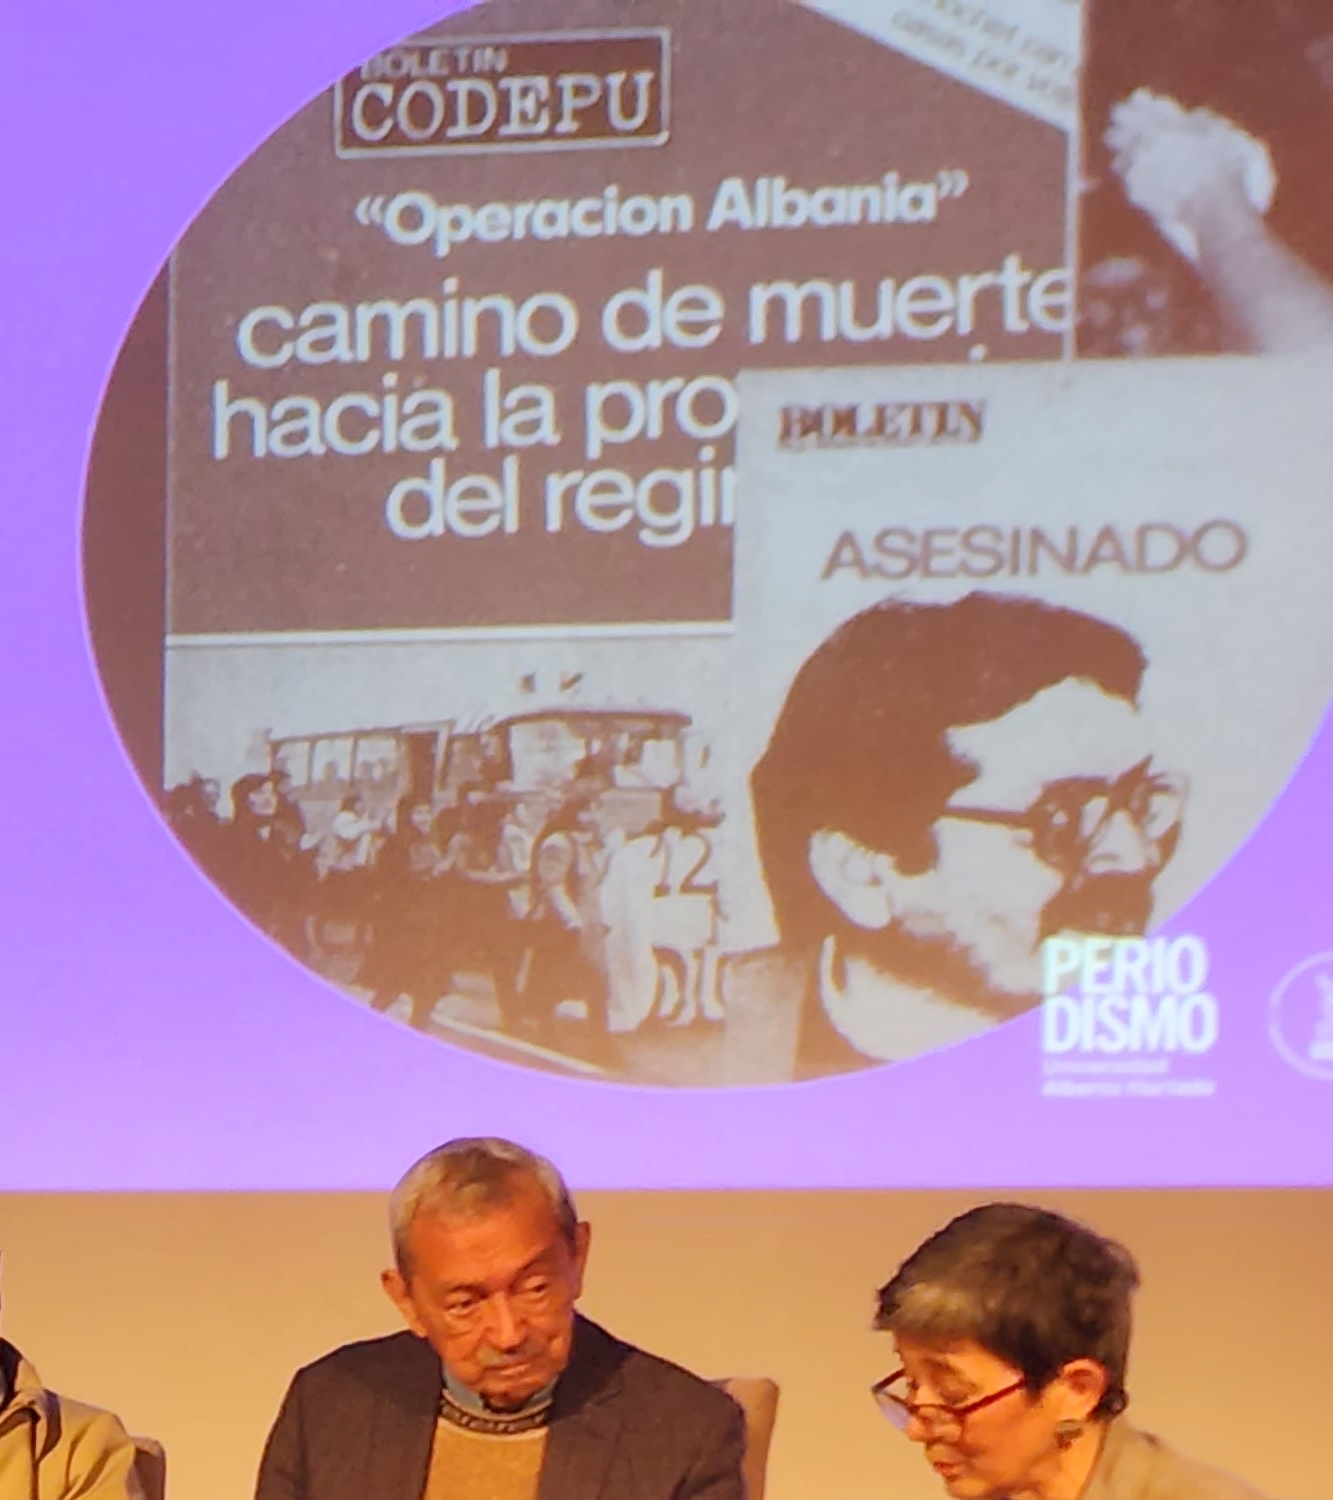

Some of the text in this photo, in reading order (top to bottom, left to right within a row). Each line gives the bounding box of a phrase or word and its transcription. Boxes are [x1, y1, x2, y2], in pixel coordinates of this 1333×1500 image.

[352, 71, 654, 141] CODEPU
[237, 253, 1073, 368] camino de muerte
[213, 373, 458, 460] hacia
[484, 368, 561, 449] la
[777, 400, 986, 451] BOLETIN
[386, 445, 735, 548] del regi
[821, 519, 1248, 581] ASESINADO
[1043, 933, 1210, 995] PERIO
[1042, 993, 1219, 1054] DISMO
